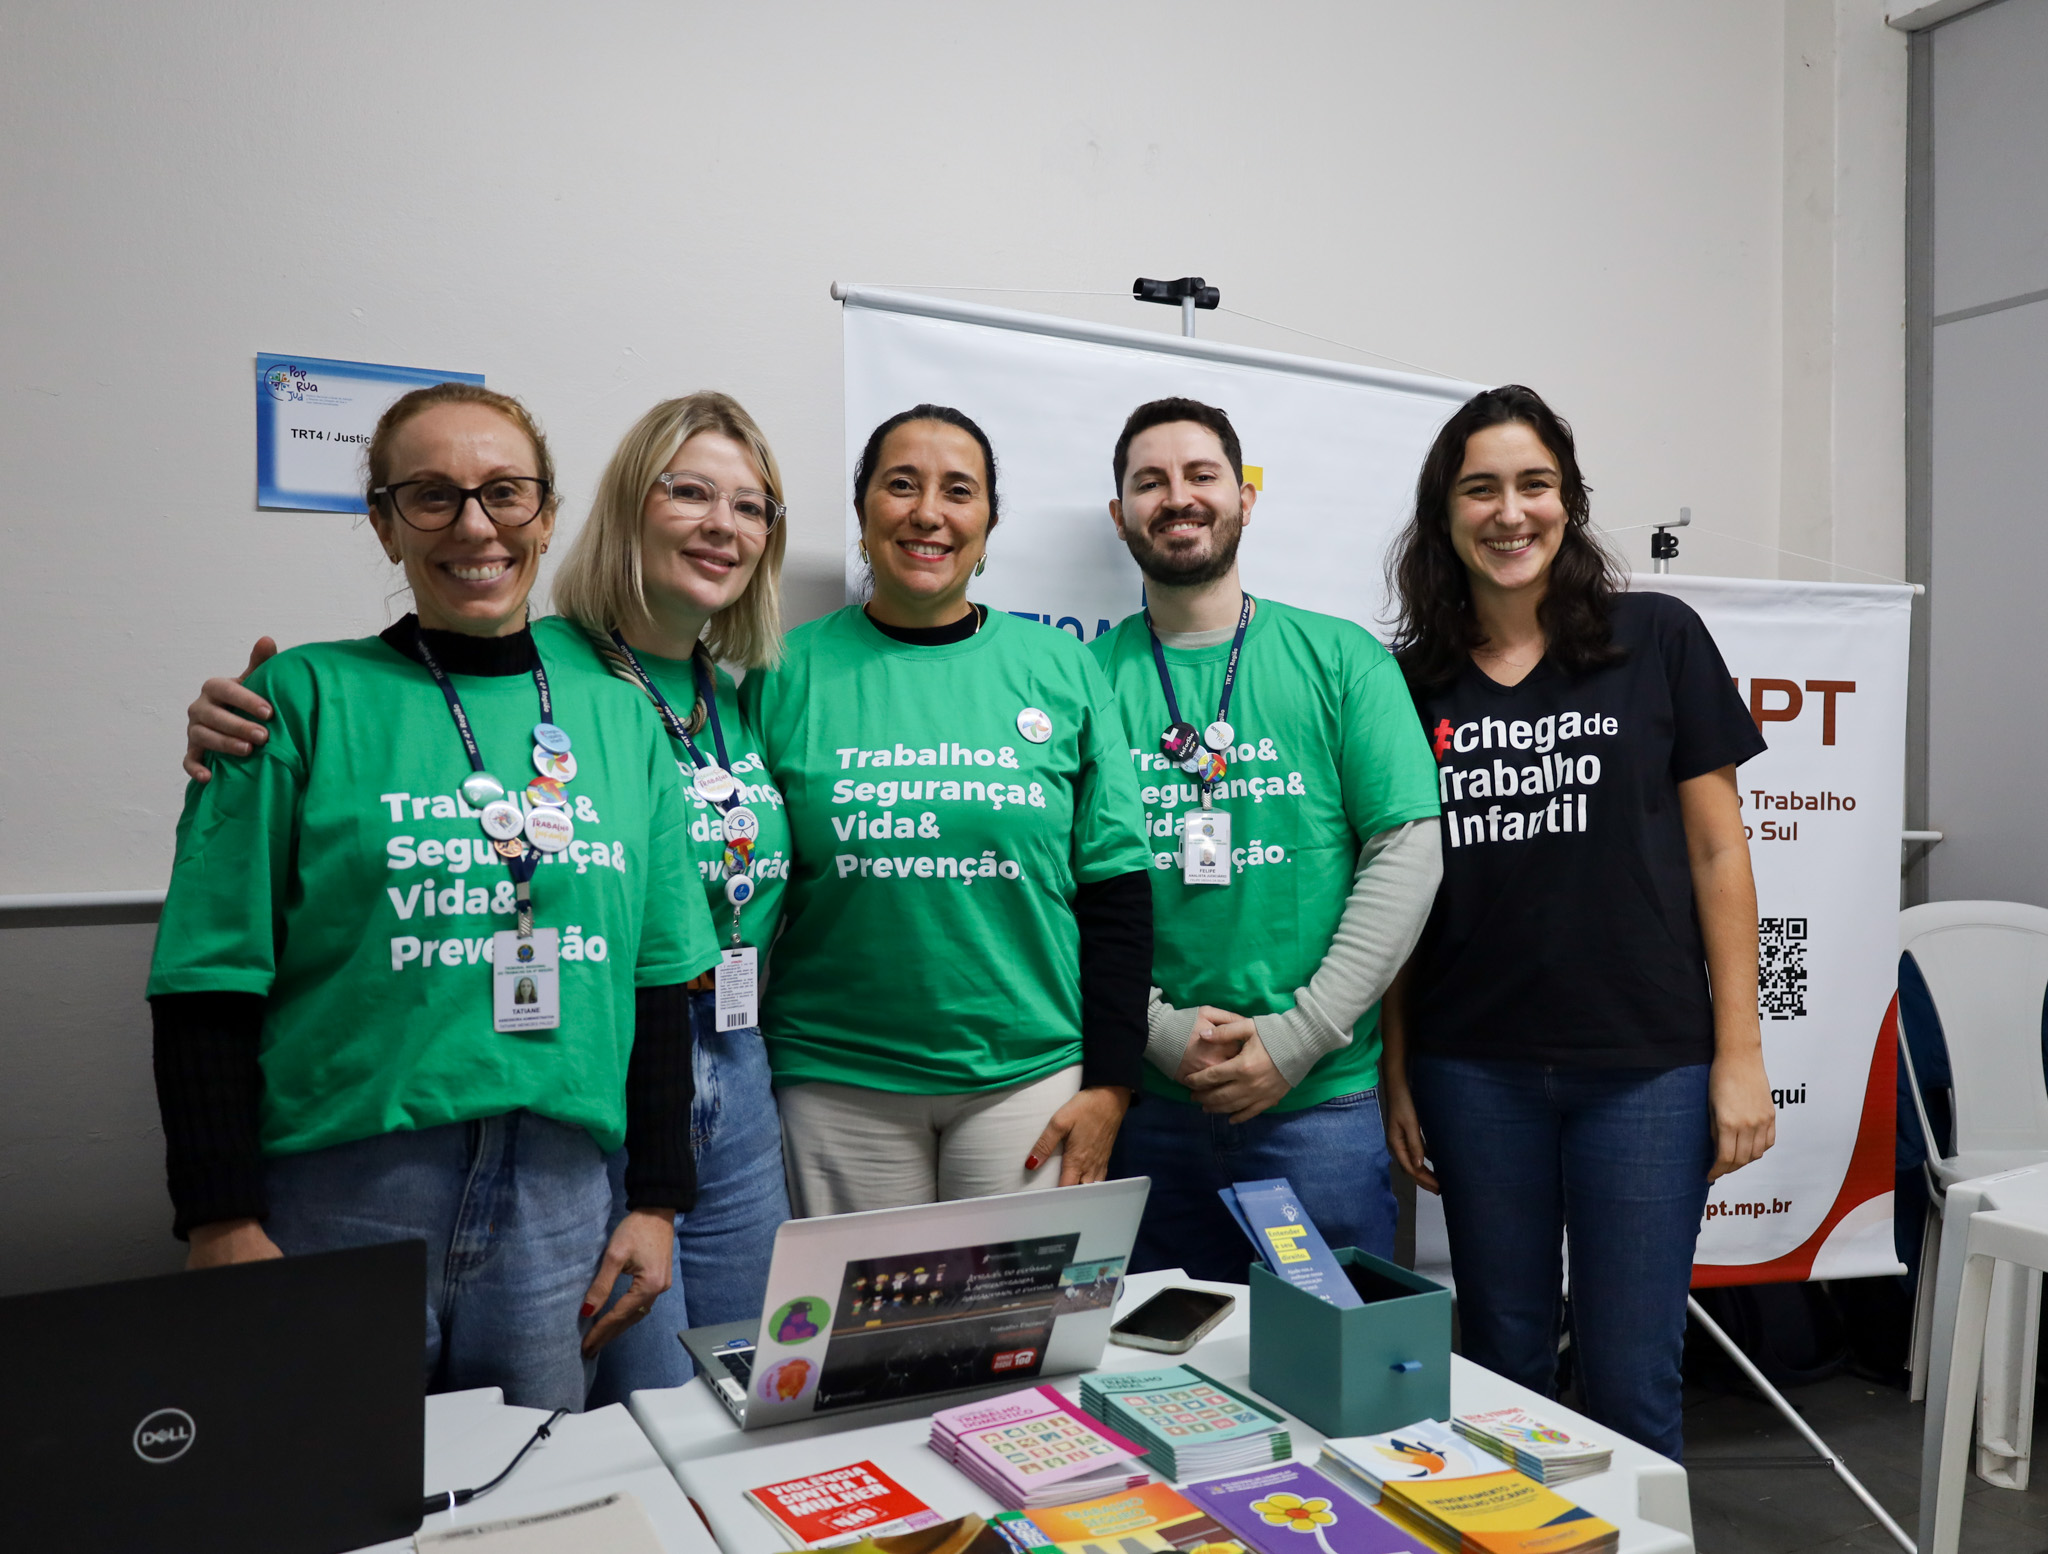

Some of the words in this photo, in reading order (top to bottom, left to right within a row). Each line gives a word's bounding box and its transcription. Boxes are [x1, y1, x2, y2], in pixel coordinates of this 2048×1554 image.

[289, 365, 307, 381] Pop
[291, 428, 323, 440] TRT4
[326, 432, 331, 441] /
[334, 432, 371, 444] Justiç
[620, 645, 636, 665] Região
[1225, 674, 1233, 686] TRT
[1229, 647, 1239, 666] Região
[640, 672, 650, 684] TRT
[535, 669, 545, 681] TRT
[541, 690, 551, 713] Região
[453, 703, 467, 728] Região
[664, 705, 680, 726] Região
[1731, 678, 1856, 746] PT
[465, 739, 477, 754] TRT
[681, 735, 692, 748] TRT
[835, 742, 1020, 770] Trabalho&
[1439, 752, 1601, 803] Trabalho
[831, 778, 1047, 810] Segurança&
[1750, 790, 1856, 812] Trabalho
[830, 810, 941, 842] Vida&
[1447, 793, 1588, 848] Infantil
[1760, 821, 1798, 841] Sul
[835, 850, 1025, 885] Prevenção.
[387, 878, 517, 921] Vida&
[512, 1007, 541, 1015] TATIANE
[1771, 1083, 1806, 1109] qui
[1705, 1198, 1792, 1220] pt.mp.br
[1267, 1228, 1301, 1237] Entender
[142, 1426, 189, 1446] DELL
[777, 1478, 859, 1505] CONTRA
[860, 1474, 879, 1486] A
[786, 1483, 891, 1517] MULHER
